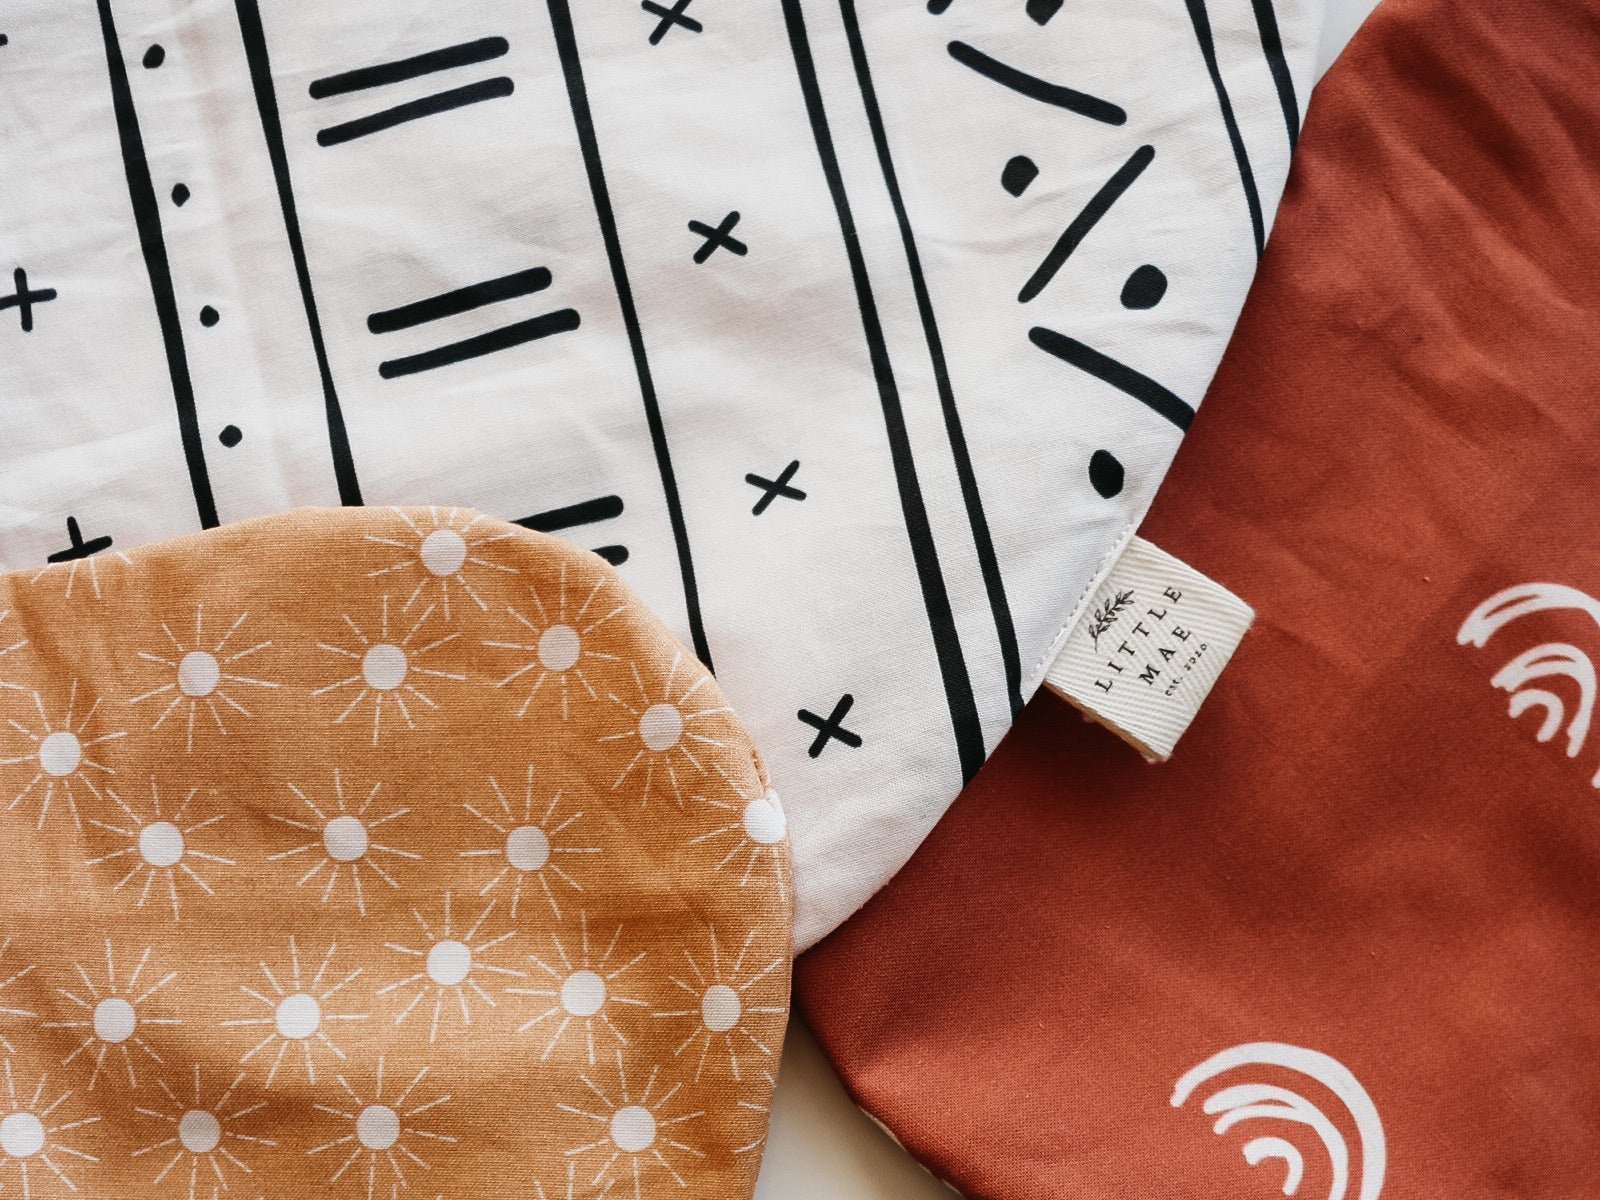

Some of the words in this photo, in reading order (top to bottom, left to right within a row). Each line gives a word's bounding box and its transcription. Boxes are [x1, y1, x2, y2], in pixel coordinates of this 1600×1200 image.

[1095, 586, 1182, 693] LITTLE
[1138, 626, 1191, 685] MAE
[1165, 676, 1183, 697] est.
[1184, 643, 1208, 671] 2020
